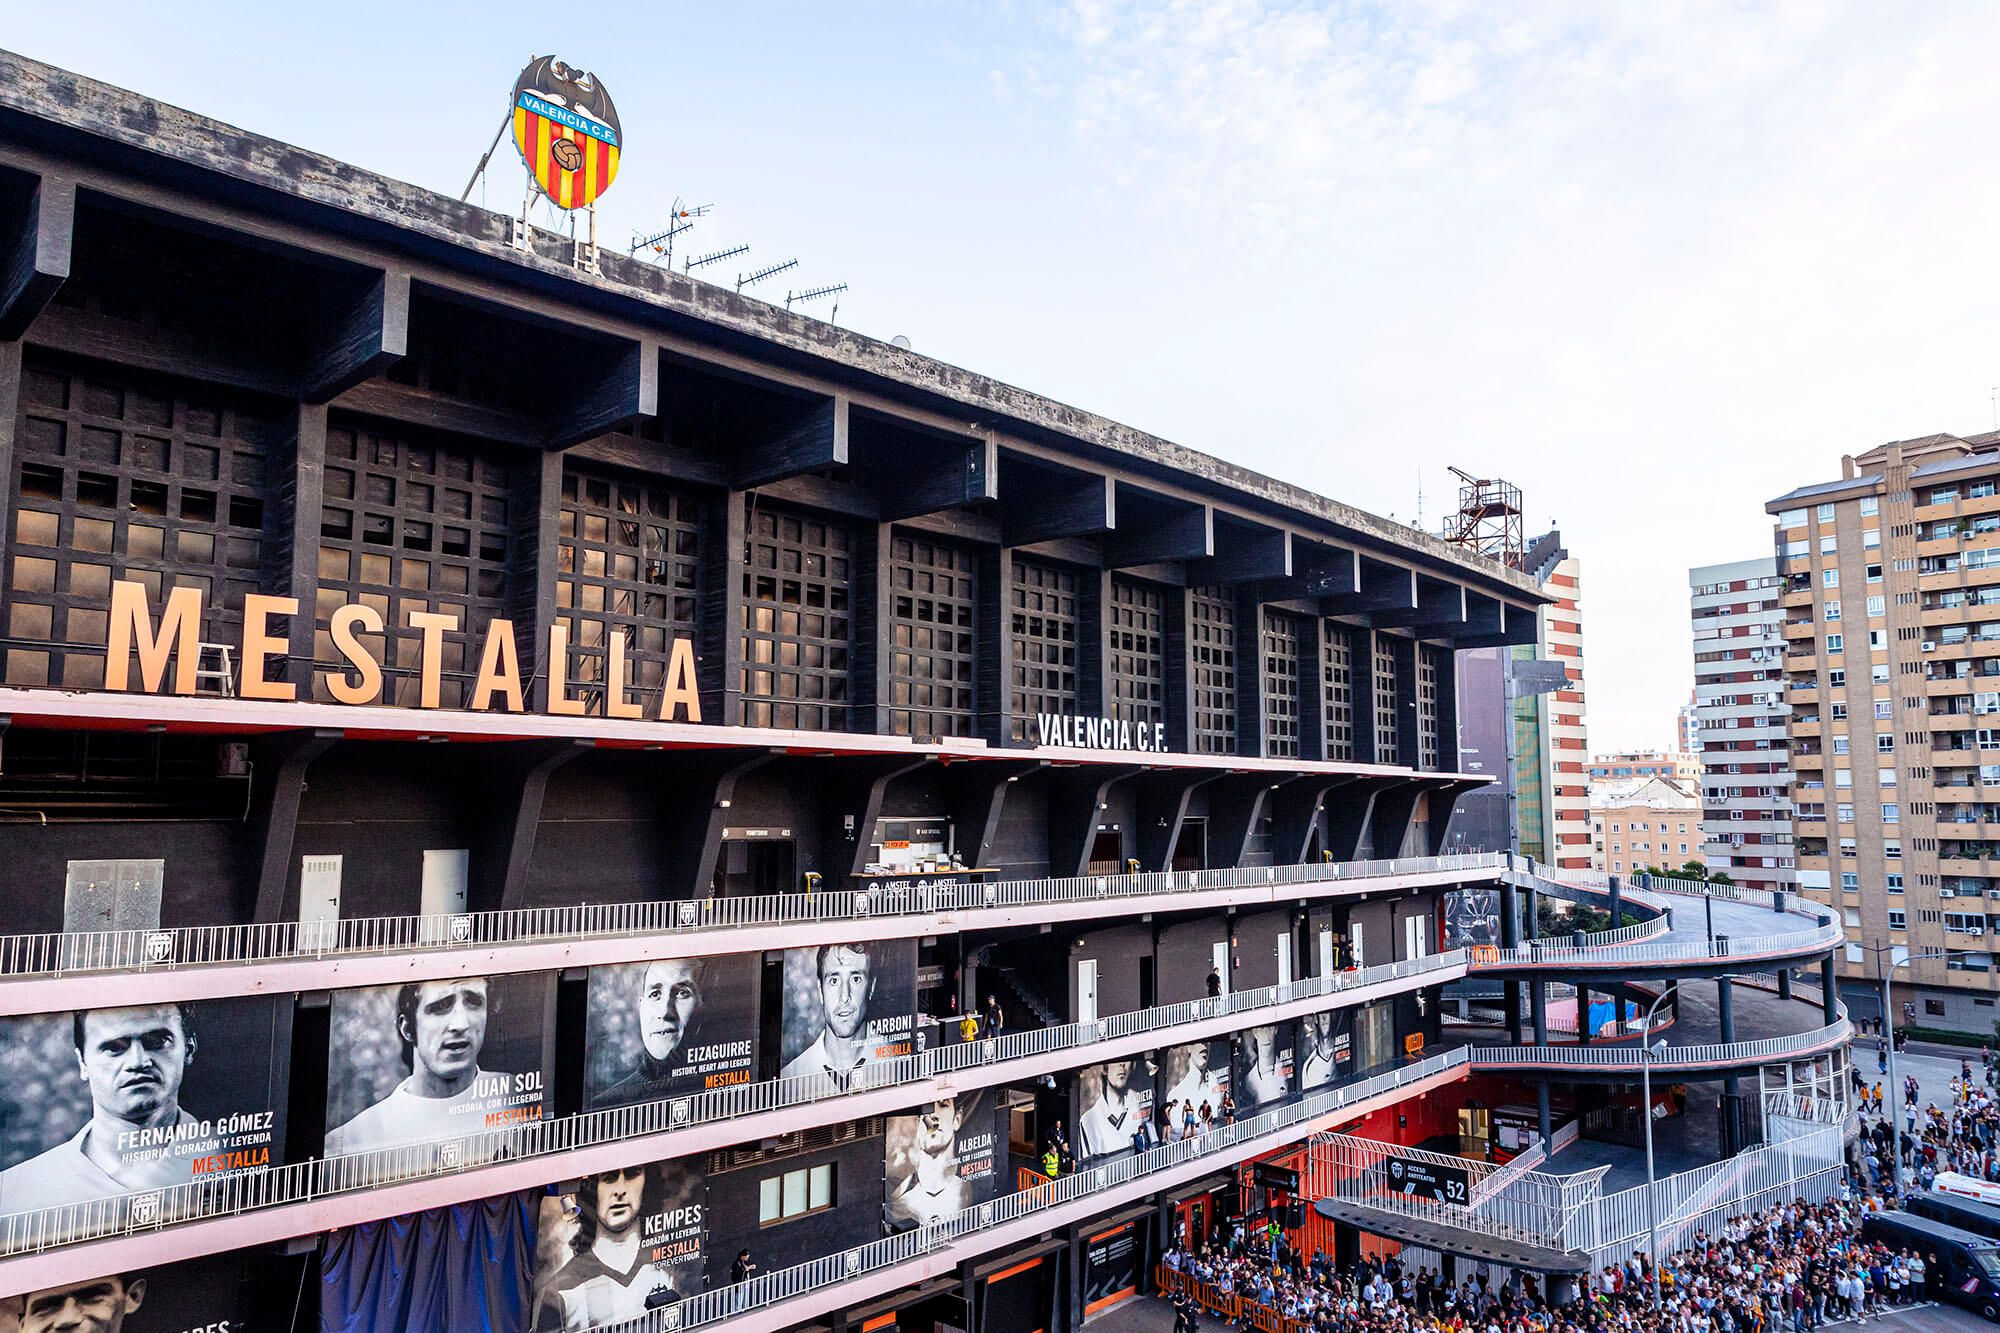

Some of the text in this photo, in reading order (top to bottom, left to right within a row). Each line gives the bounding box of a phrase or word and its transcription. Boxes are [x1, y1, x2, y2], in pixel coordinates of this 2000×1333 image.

[524, 95, 614, 141] VALENCIA C.F.
[105, 580, 702, 722] MESTALLA
[1037, 713, 1169, 752] VALENCIA C.F.
[870, 1015, 912, 1035] CARBONI
[687, 1040, 751, 1063] EIZAGUIRRE
[876, 1043, 911, 1058] MESTALLA
[672, 1058, 751, 1078] HISTORY, HEART AND LEGEND
[705, 1070, 750, 1089] MESTALLA
[471, 1071, 543, 1099] JUAN SOL
[487, 1099, 501, 1109] COR
[508, 1092, 543, 1106] LLEGENDA
[485, 1105, 543, 1128] MESTALLA
[117, 1111, 274, 1150] FERNANDO GÓMEZ
[122, 1131, 271, 1164] HISTORIA, CORAZÓN Y LEYENDA
[958, 1133, 992, 1153] ALBELDA
[192, 1147, 270, 1174] MESTALLA
[961, 1158, 992, 1176] MESTALLA
[1407, 1165, 1426, 1174] ACCESO
[1447, 1180, 1465, 1200] 52
[645, 1204, 702, 1235] KEMPES
[641, 1233, 669, 1248] CORAZÓN
[675, 1225, 701, 1239] LEYENDA
[652, 1238, 700, 1262] MESTALLA
[653, 1251, 700, 1269] FOREVERTOUR
